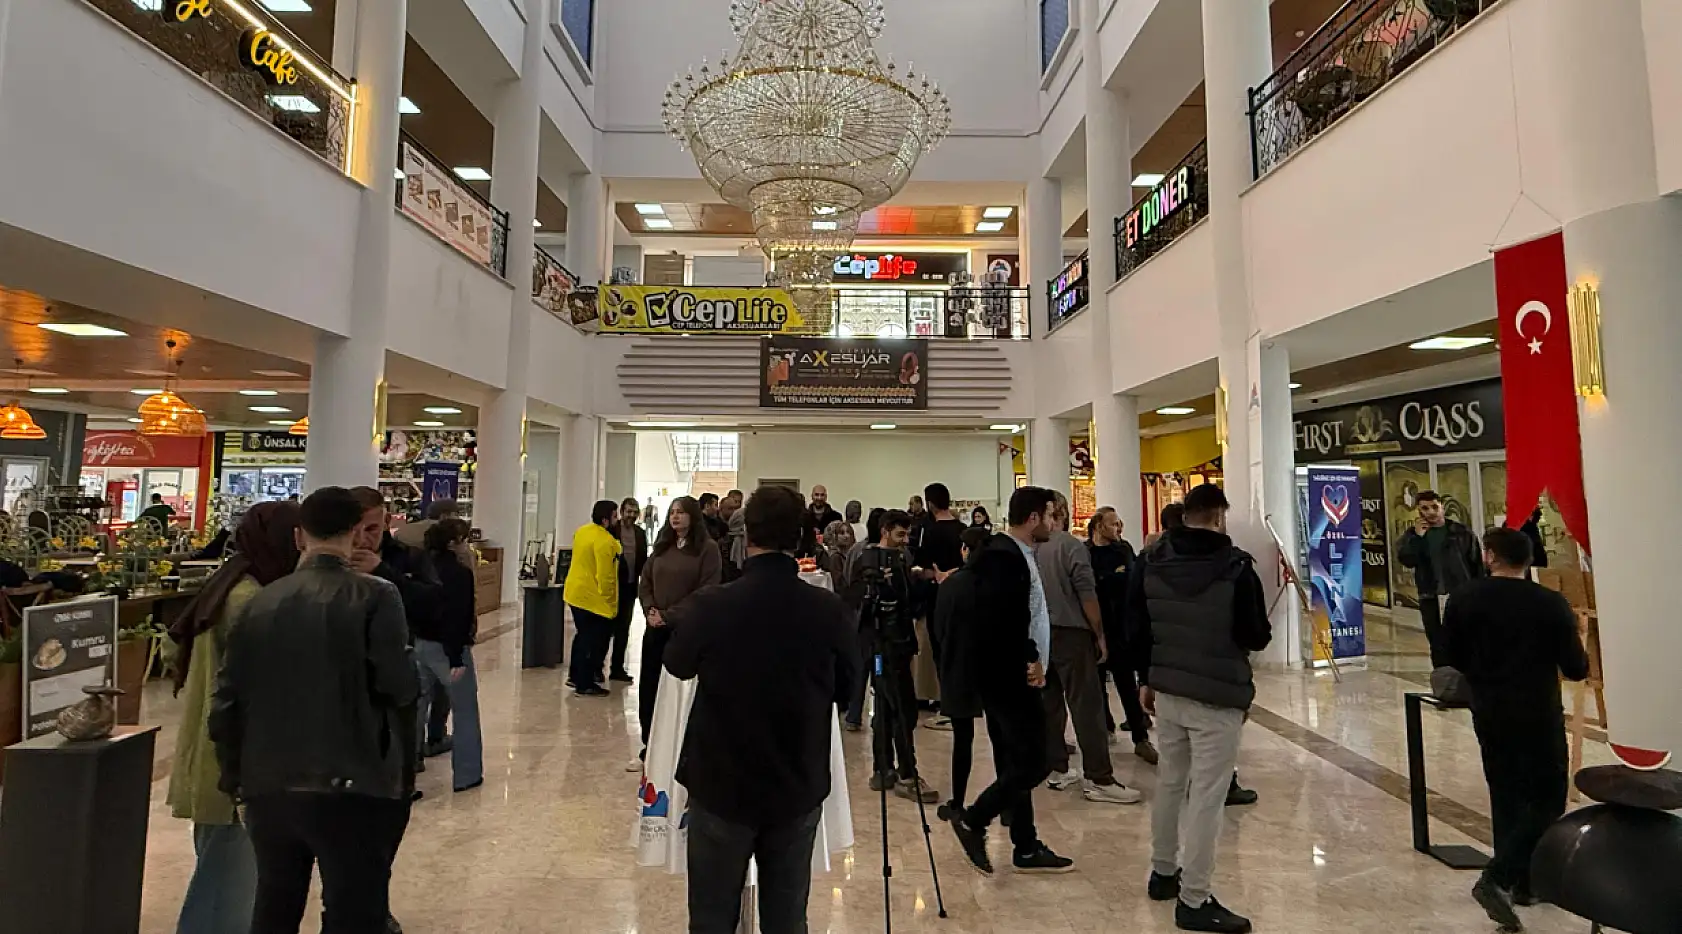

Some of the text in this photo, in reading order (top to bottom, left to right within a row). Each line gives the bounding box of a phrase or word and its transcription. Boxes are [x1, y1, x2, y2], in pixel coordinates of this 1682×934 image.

[250, 31, 298, 85] Cafe
[1125, 165, 1189, 250] ET DÖNER
[264, 435, 297, 448] ÜNSAL
[1293, 400, 1484, 454] FIRST CLASS
